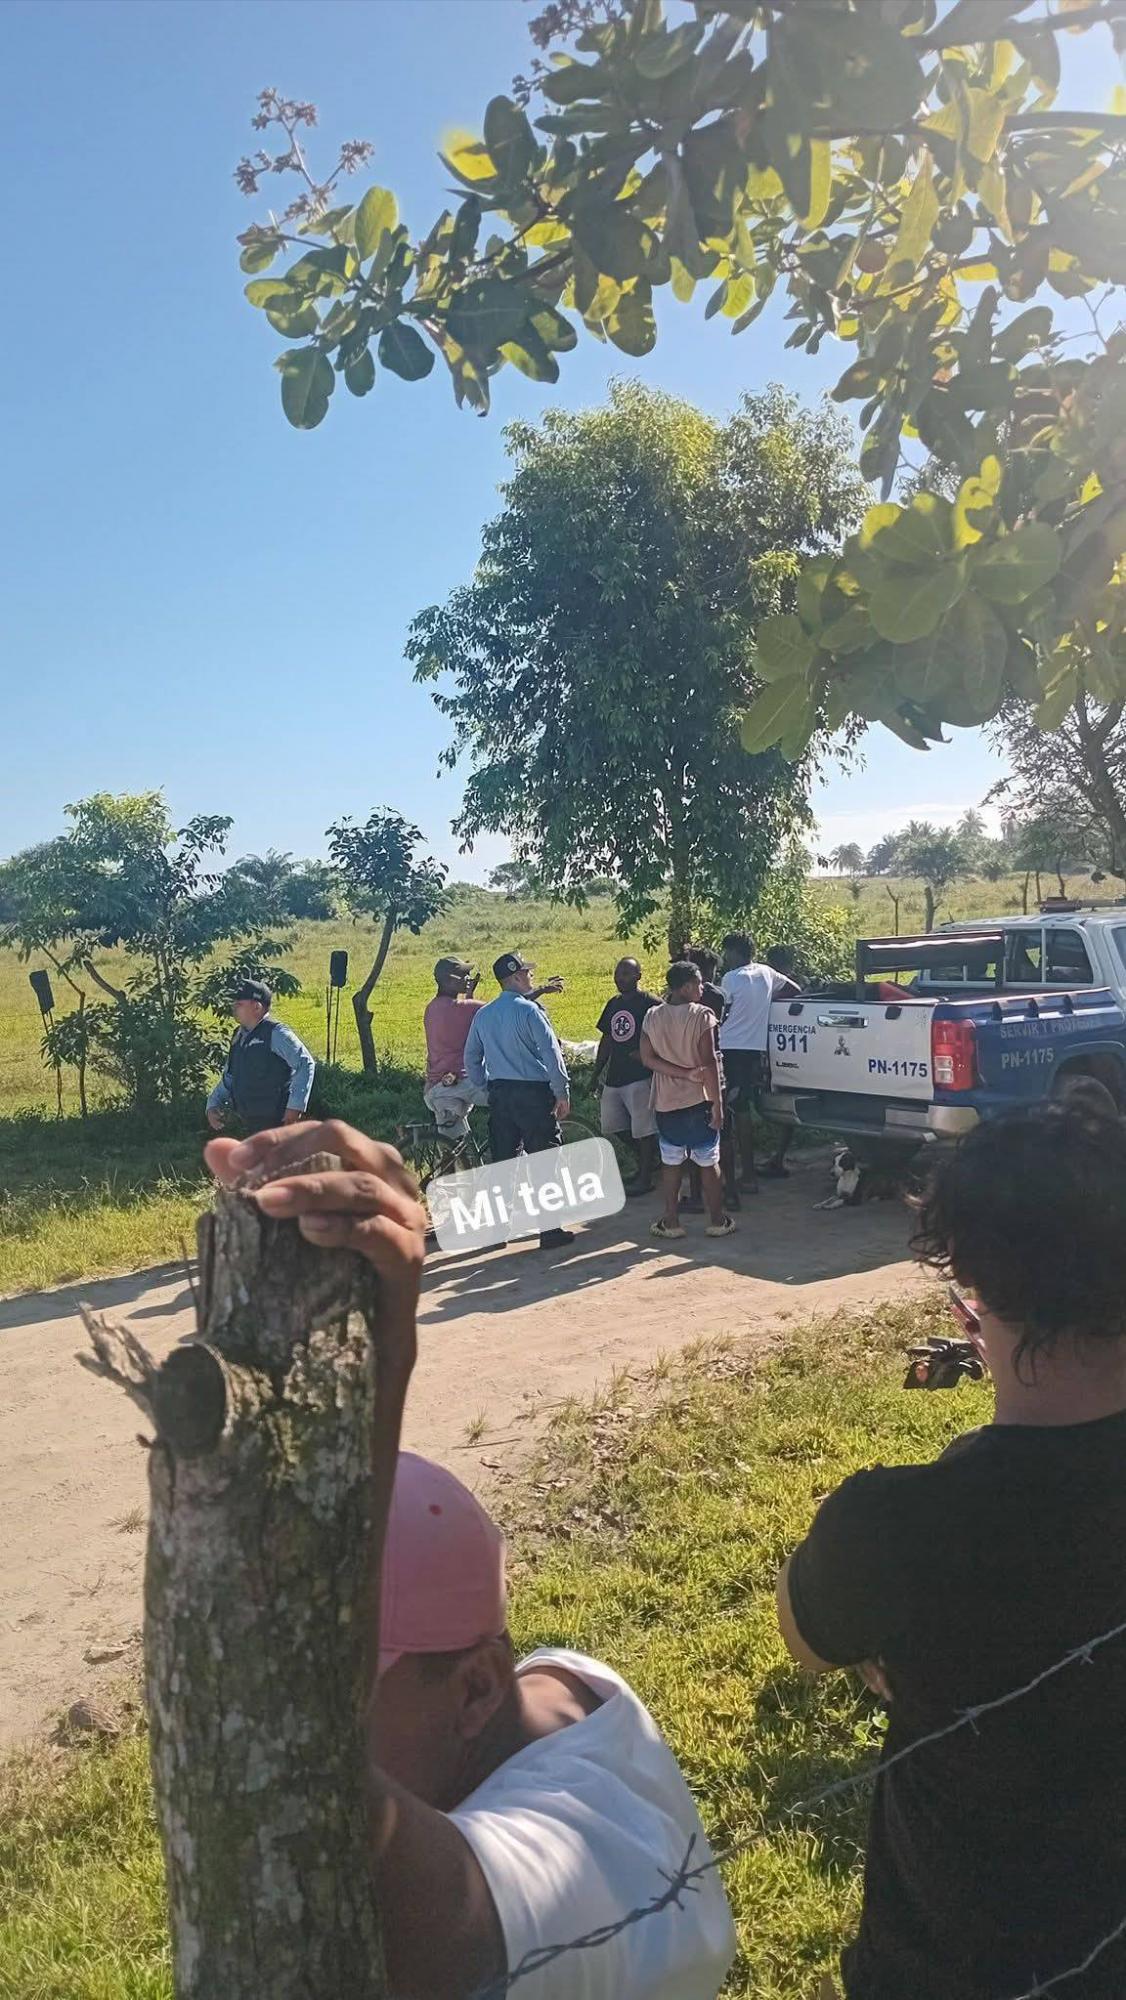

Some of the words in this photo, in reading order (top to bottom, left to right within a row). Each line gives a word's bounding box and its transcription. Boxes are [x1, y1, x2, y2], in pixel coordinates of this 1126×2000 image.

[768, 1024, 816, 1035] EMERGENCIA
[1000, 1021, 1039, 1039] SERVIR
[1040, 1020, 1048, 1033] Y
[776, 1033, 808, 1053] 911
[868, 1058, 928, 1078] PN-1175
[1001, 1047, 1054, 1069] PN-1175
